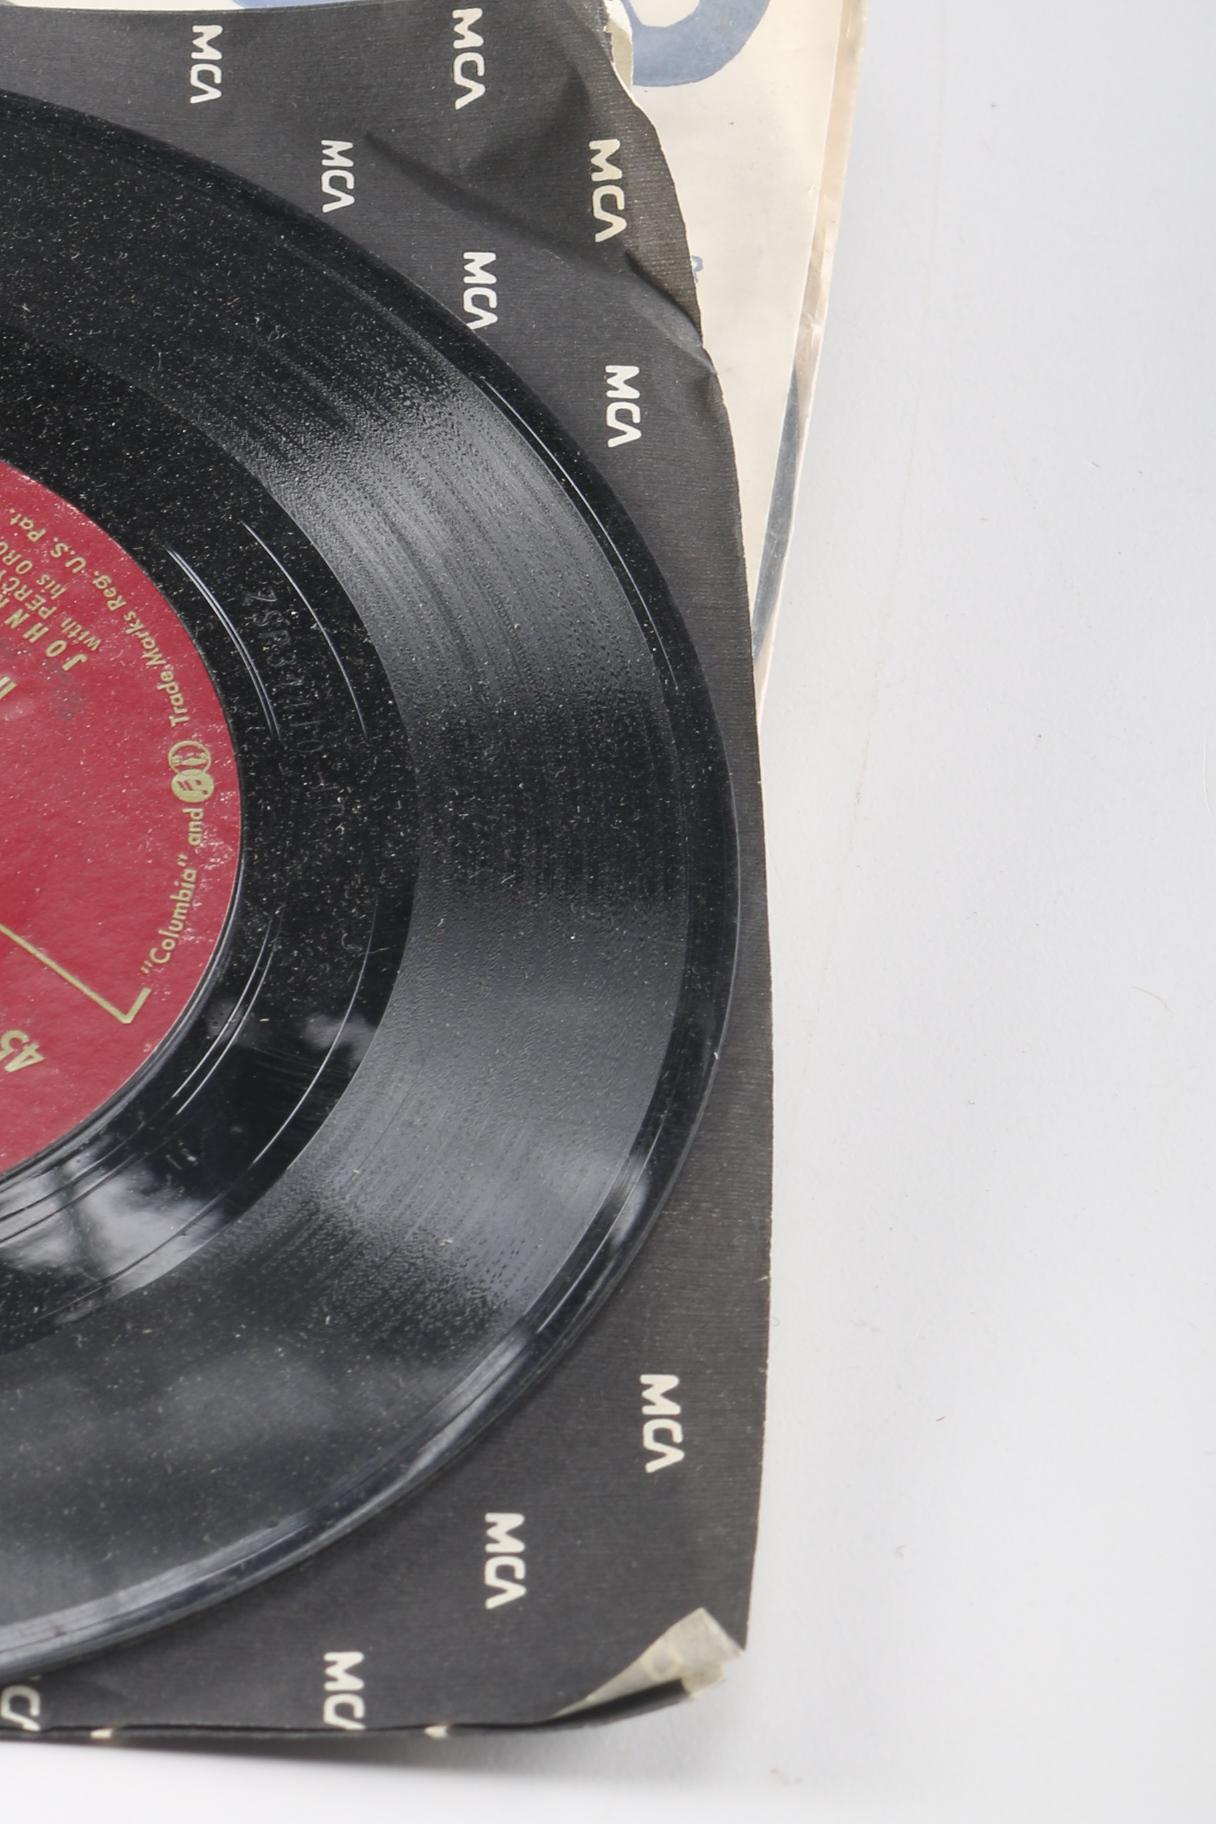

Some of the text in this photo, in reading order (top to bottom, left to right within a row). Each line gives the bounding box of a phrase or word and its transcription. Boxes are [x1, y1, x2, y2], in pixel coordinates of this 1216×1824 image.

[190, 25, 222, 103] MCA
[453, 8, 485, 109] MCA
[321, 140, 355, 213] MCA
[589, 139, 627, 242] MCA
[463, 251, 498, 330] MCA
[606, 365, 641, 447] MCA
[8, 508, 47, 542] Pat.
[36, 574, 67, 600] his
[93, 571, 126, 612] Reg.
[59, 618, 102, 652] with
[123, 610, 166, 668] Marks
[157, 670, 190, 726] Trade
[182, 807, 205, 846] and
[640, 1374, 684, 1473] MCA
[485, 1513, 526, 1609] MCA
